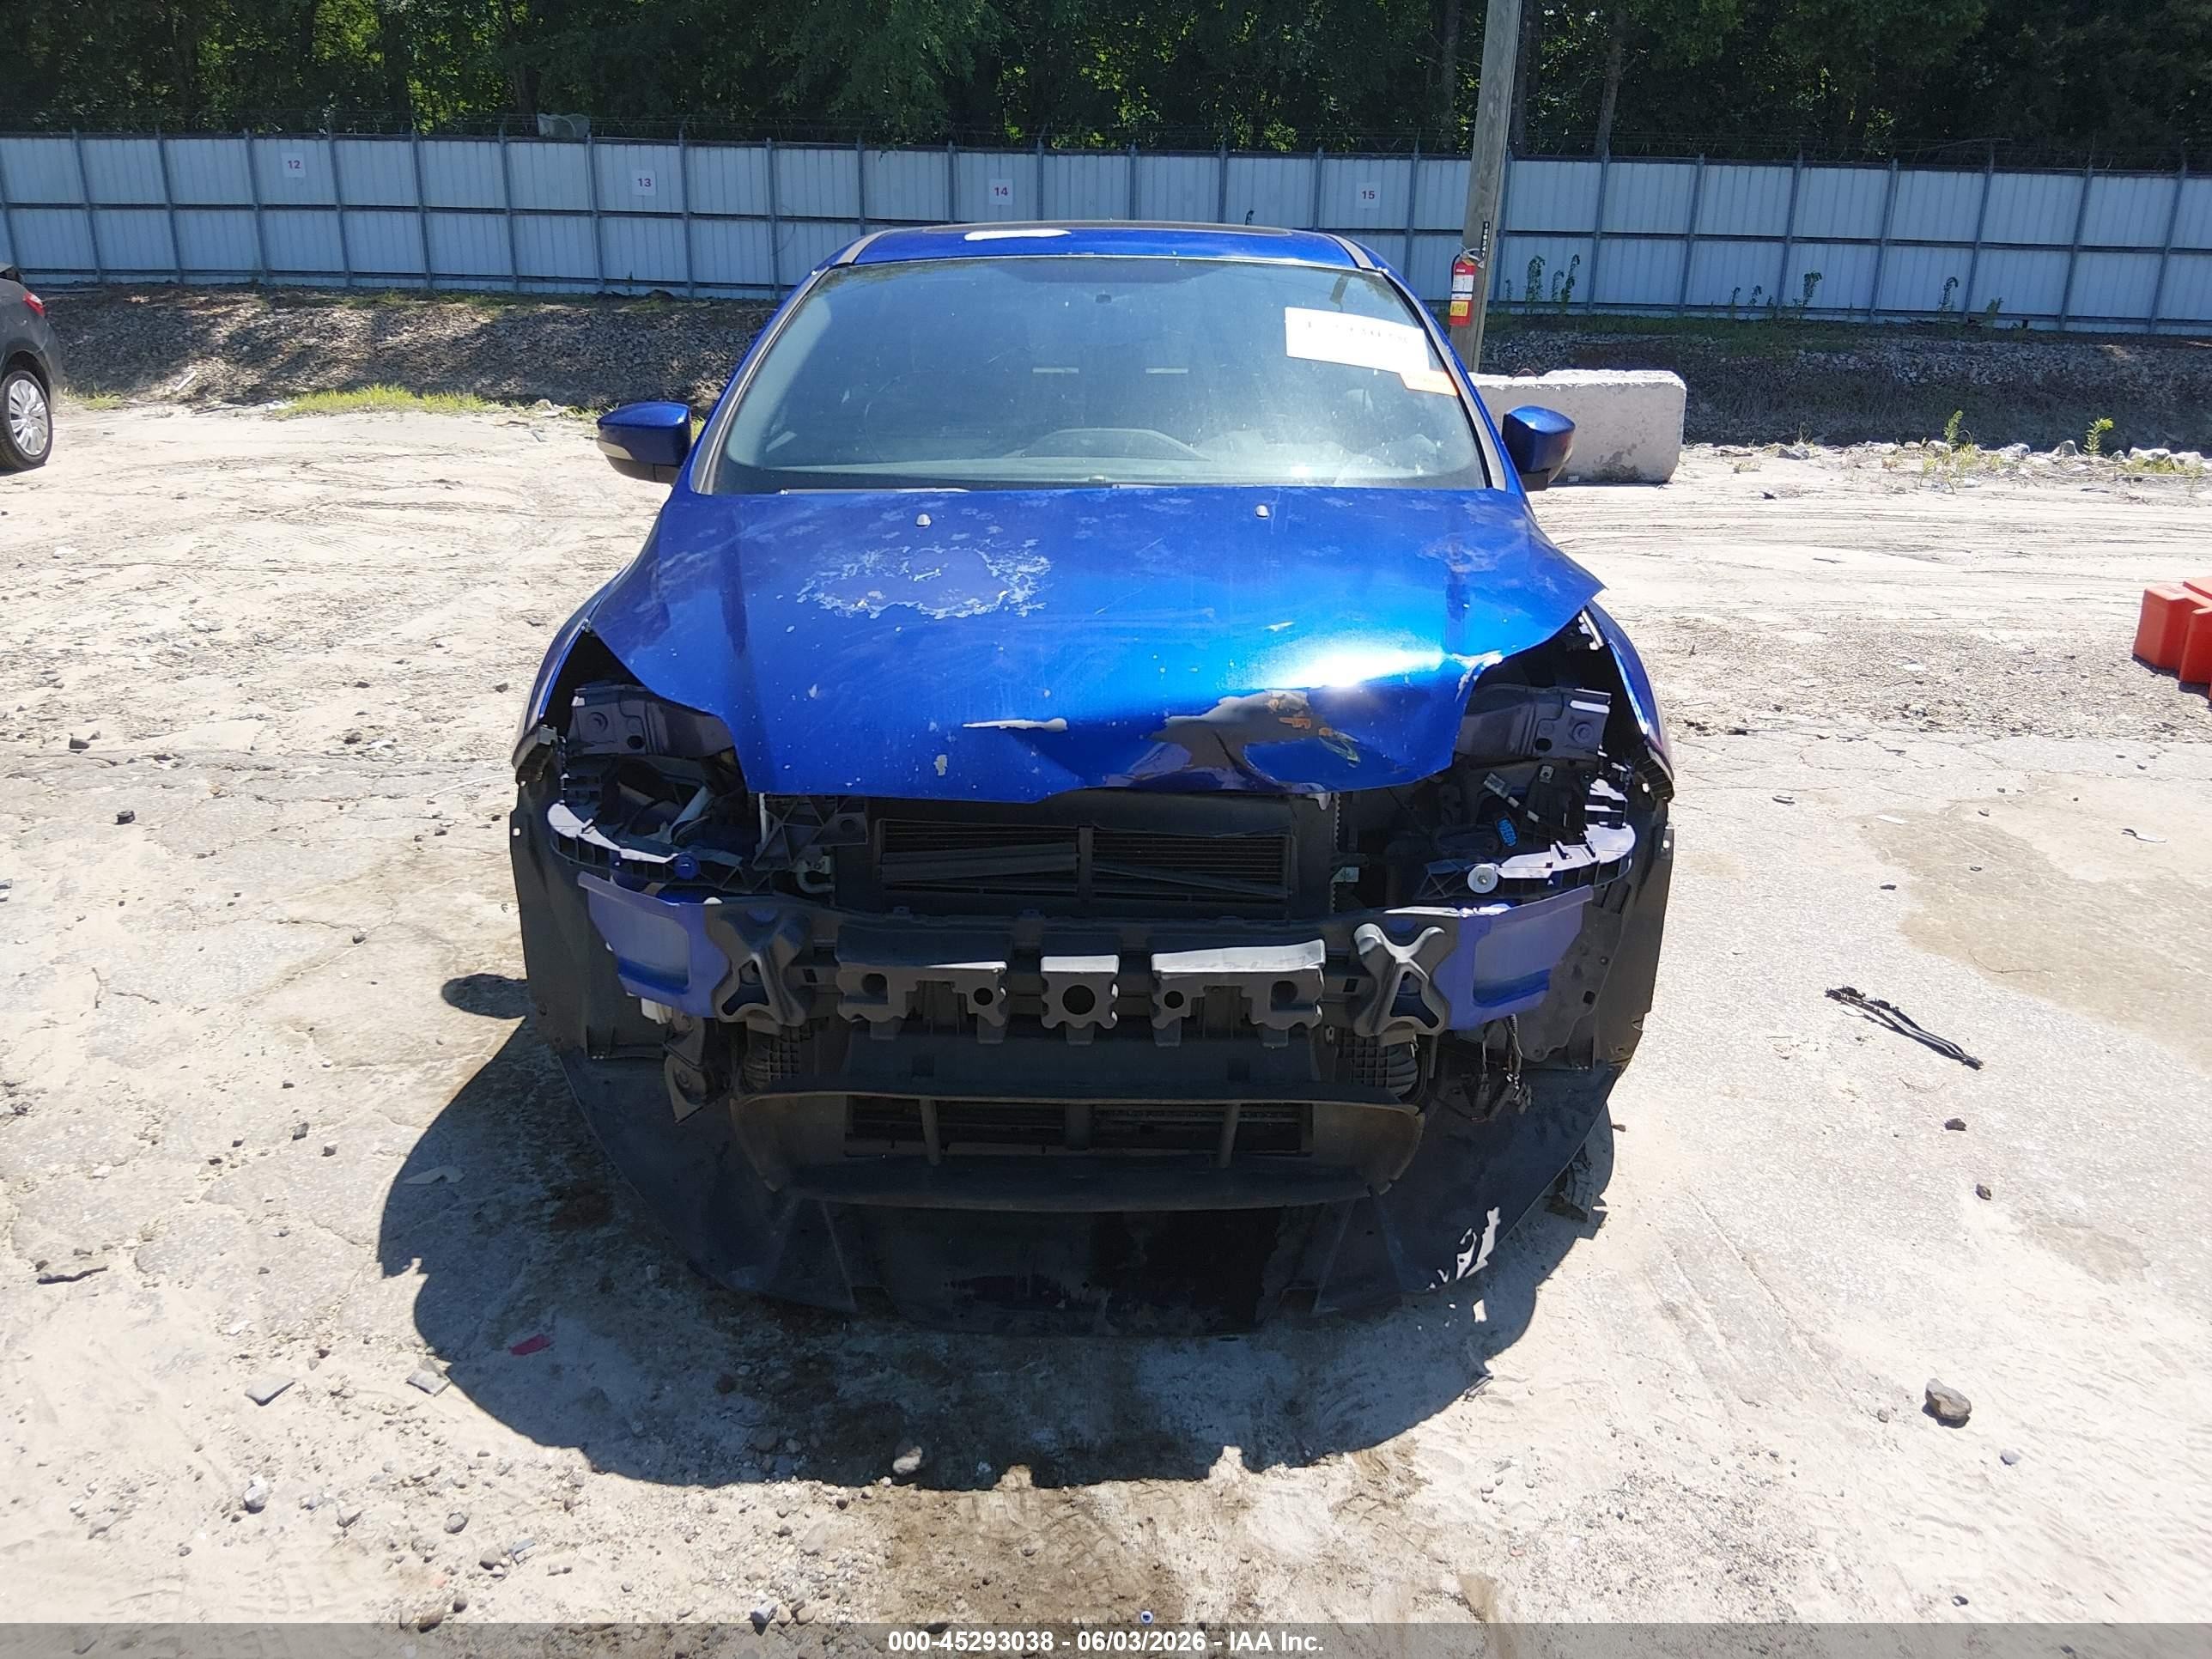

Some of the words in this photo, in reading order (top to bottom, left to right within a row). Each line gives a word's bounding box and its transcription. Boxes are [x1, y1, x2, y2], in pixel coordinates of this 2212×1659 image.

[288, 160, 301, 169] 12
[637, 178, 652, 187] 13
[994, 186, 1009, 197] 14
[1361, 190, 1376, 200] 15
